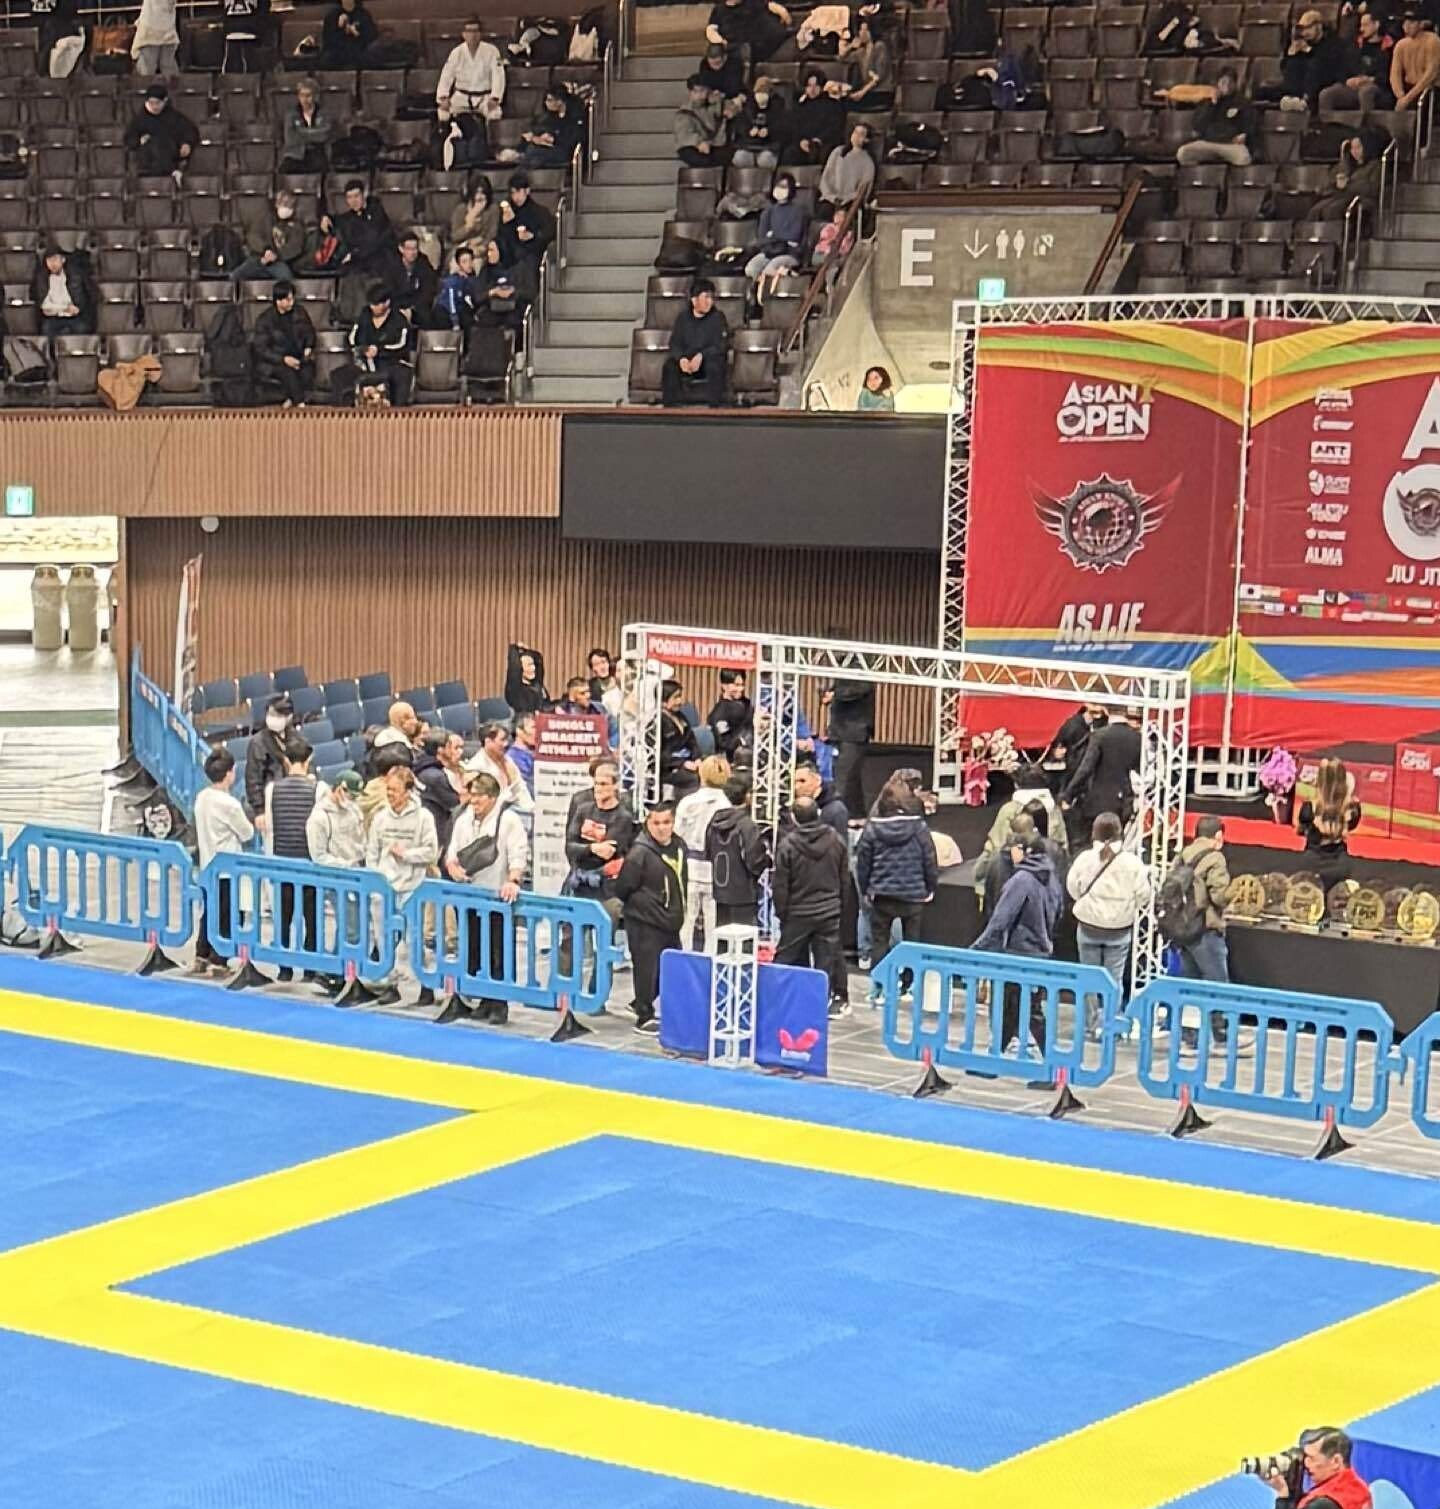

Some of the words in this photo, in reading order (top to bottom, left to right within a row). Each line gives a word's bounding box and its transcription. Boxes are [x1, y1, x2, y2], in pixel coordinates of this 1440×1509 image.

[899, 228, 935, 287] E
[1062, 380, 1137, 406] ASIAN
[1056, 403, 1151, 435] OPEN
[1304, 546, 1344, 567] ALMA
[1386, 564, 1415, 584] JIU
[1056, 602, 1145, 645] ASJJF
[695, 640, 755, 661] ENTRANCE
